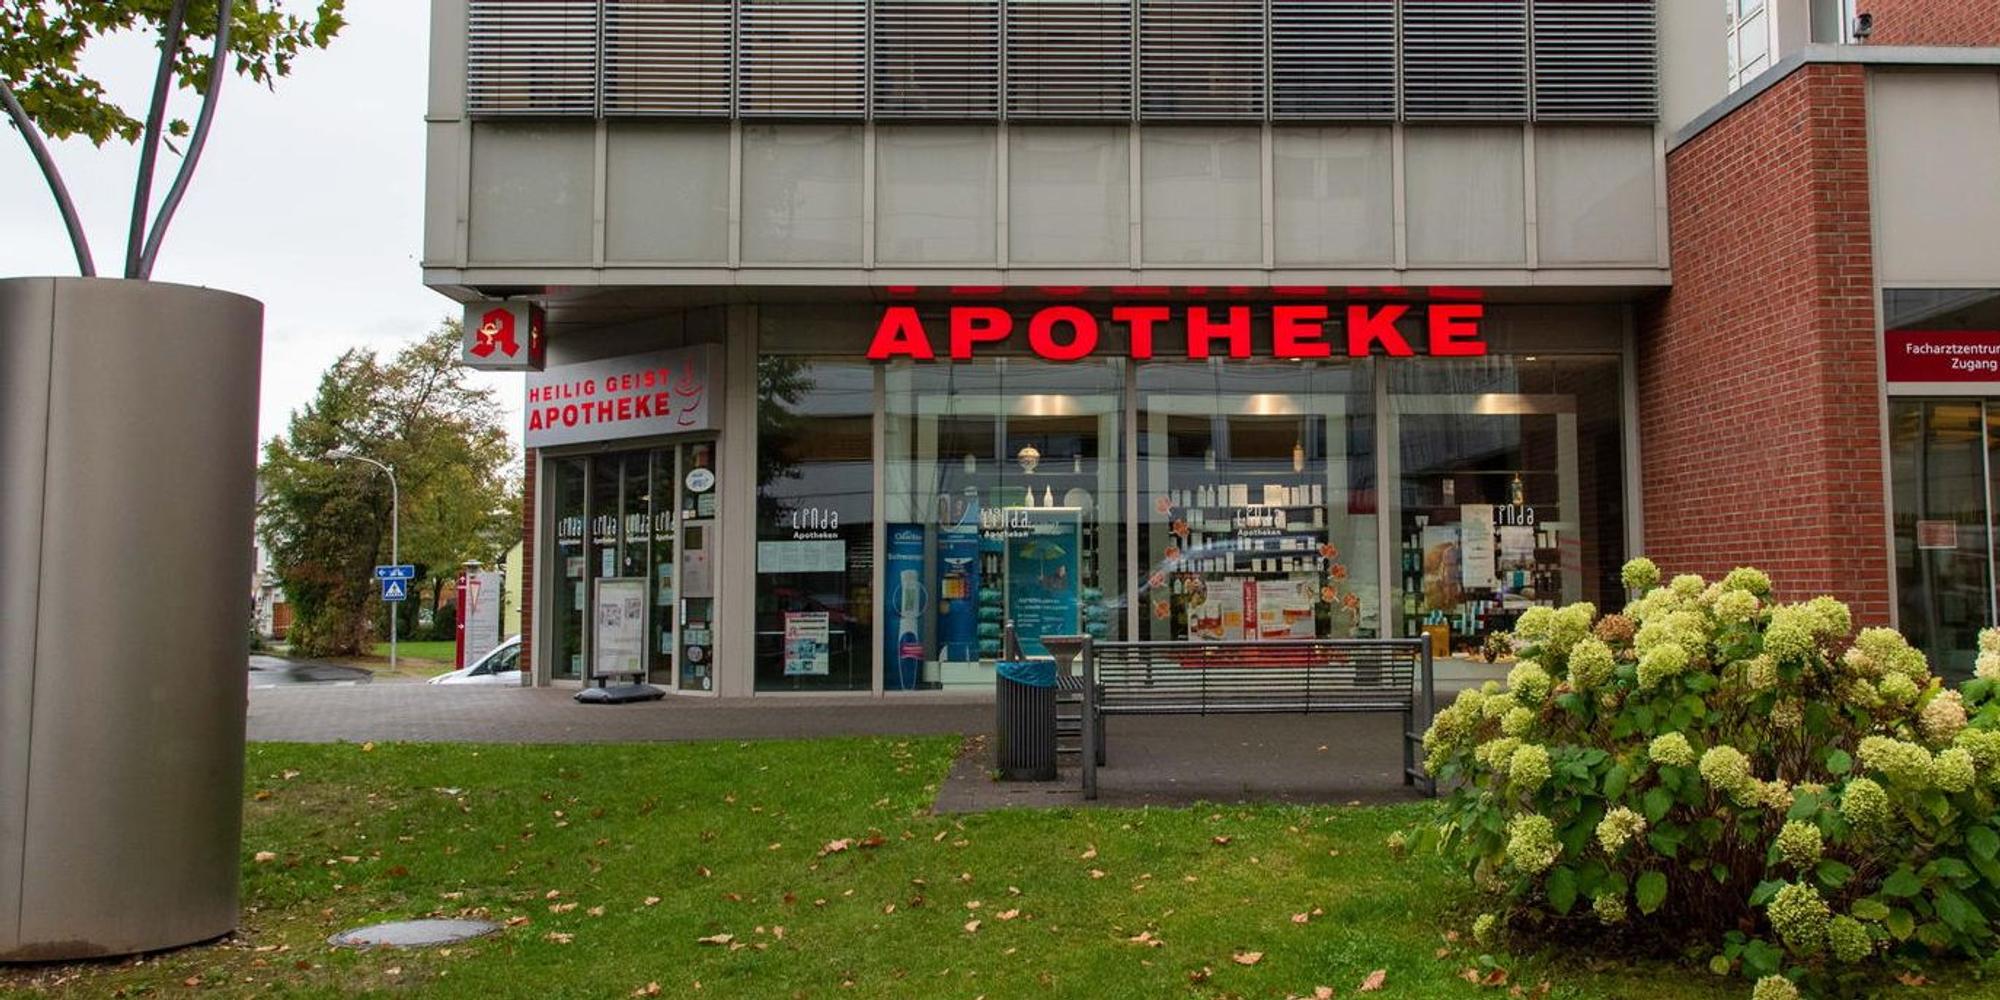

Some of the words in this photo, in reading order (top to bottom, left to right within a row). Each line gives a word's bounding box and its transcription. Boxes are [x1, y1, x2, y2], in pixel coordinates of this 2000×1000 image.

[864, 304, 1488, 361] APOTHEKE
[1951, 358, 1997, 371] Zugang
[529, 379, 596, 403] HEILIG
[606, 368, 671, 392] GEIST
[528, 391, 671, 431] APOTHEKE
